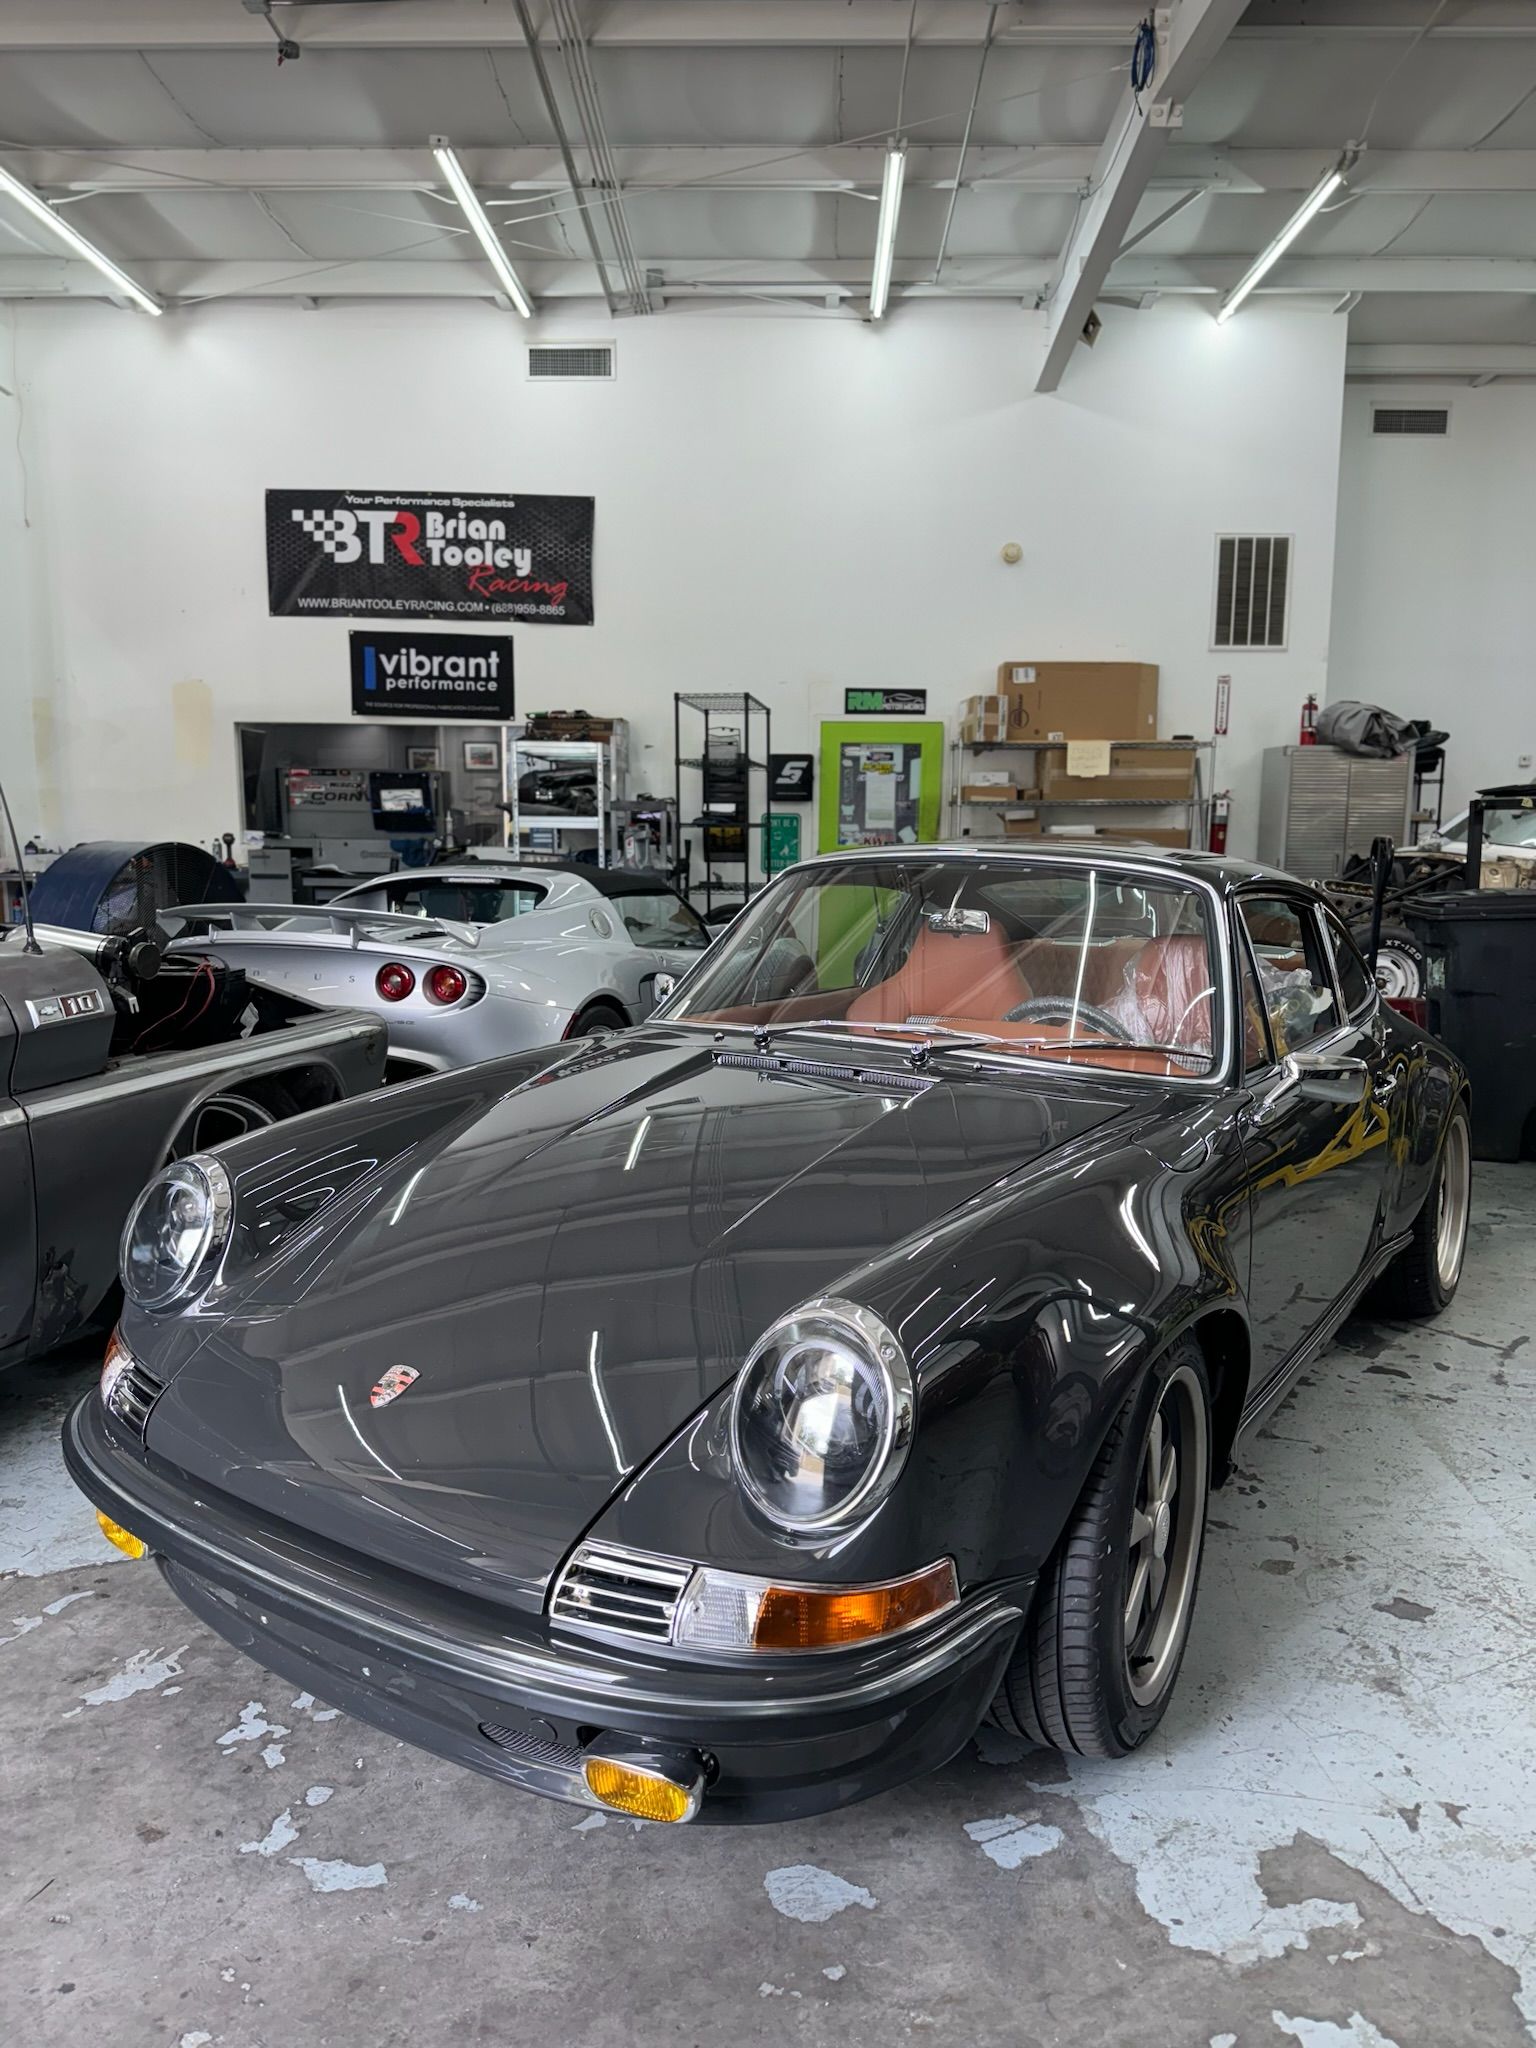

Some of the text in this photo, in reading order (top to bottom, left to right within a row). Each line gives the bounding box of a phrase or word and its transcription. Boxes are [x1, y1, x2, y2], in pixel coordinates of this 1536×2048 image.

[345, 495, 515, 508] Your Performance Specialists
[426, 511, 506, 540] Brian
[326, 509, 425, 566] BTR
[426, 539, 532, 577] Tooley
[468, 564, 568, 607] Racing
[298, 598, 483, 612] WWW.BRIANTOOLEYRACING.COM
[379, 649, 500, 678] vibrant
[386, 676, 498, 691] performance
[1385, 939, 1423, 960] XT-120
[252, 970, 356, 983] OTUS
[68, 995, 94, 1014] 10
